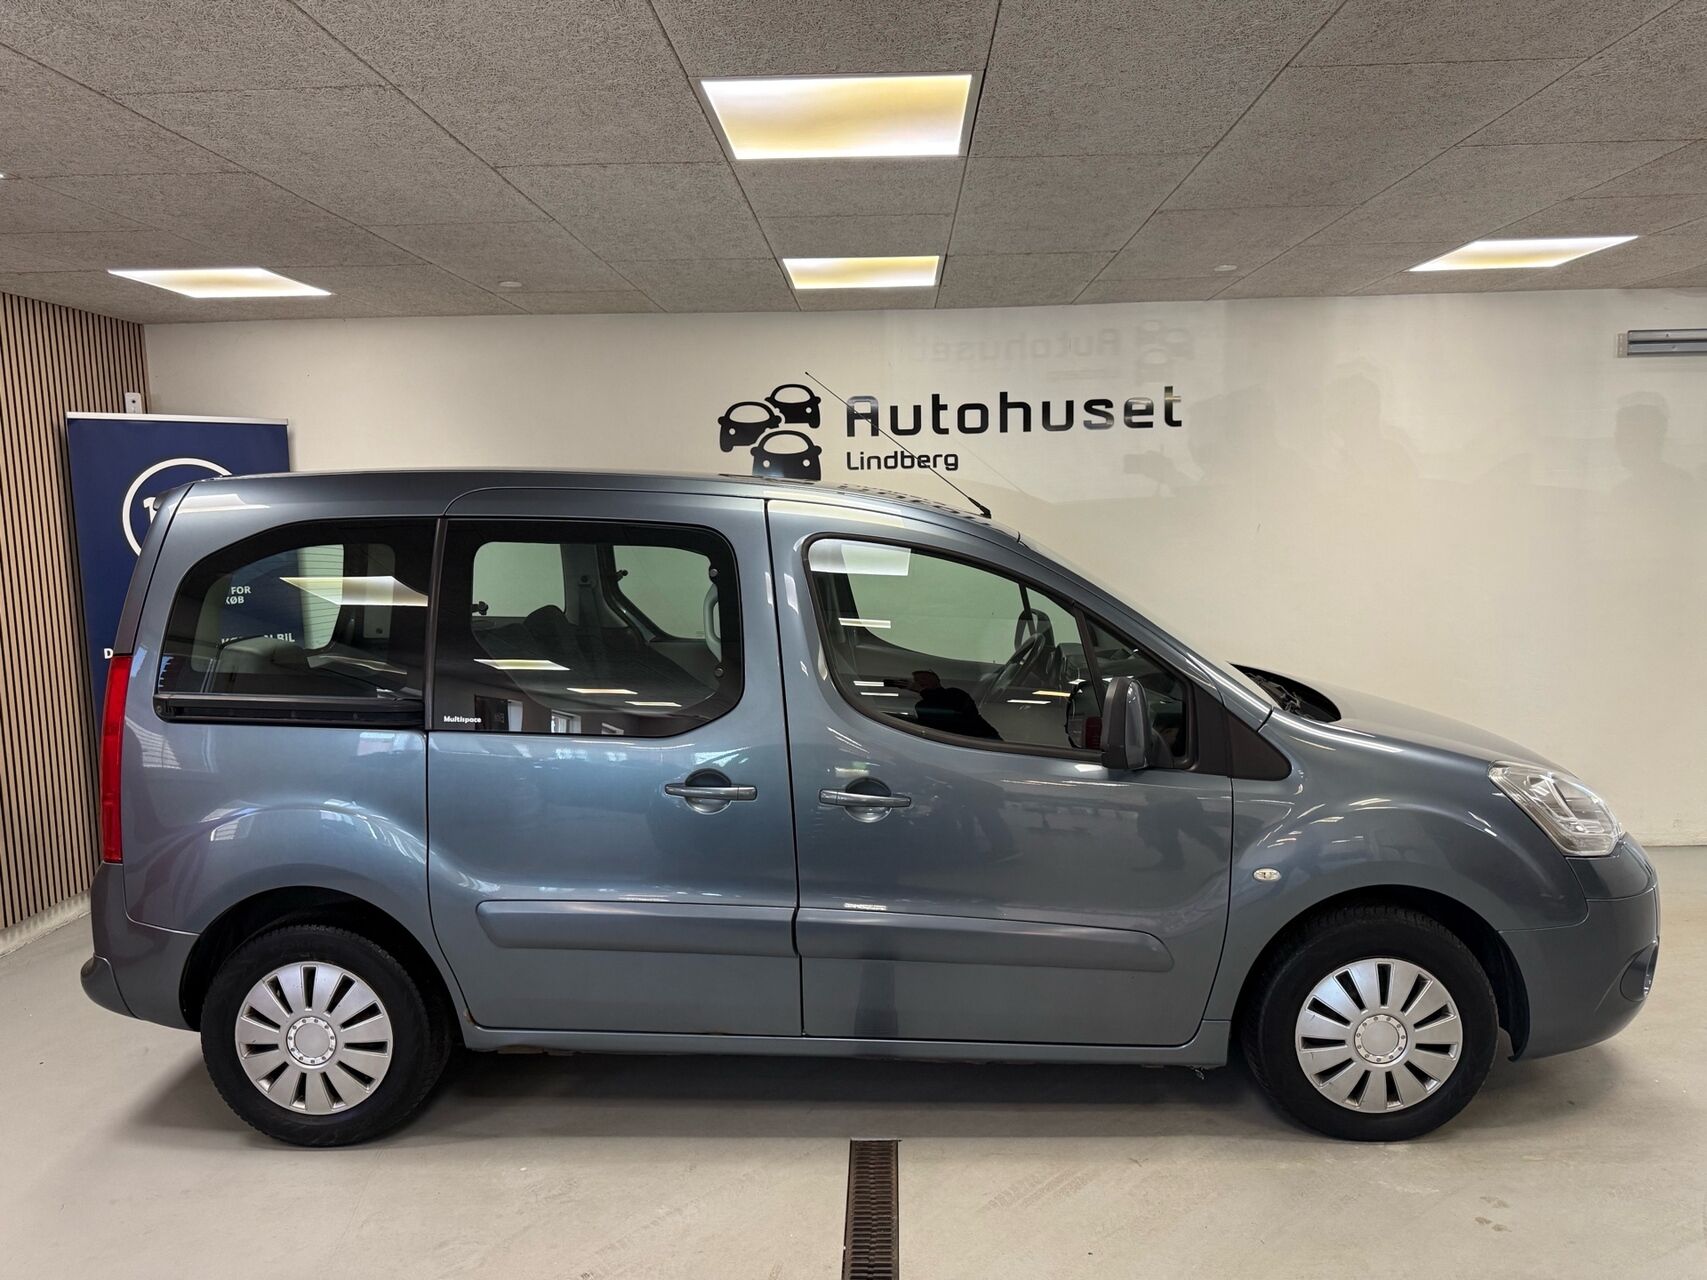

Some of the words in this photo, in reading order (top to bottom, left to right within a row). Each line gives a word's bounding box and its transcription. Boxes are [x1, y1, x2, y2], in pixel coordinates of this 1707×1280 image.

[847, 386, 1182, 436] Autohuset
[846, 451, 959, 471] Lindberg
[230, 585, 252, 595] FOR
[443, 715, 482, 724] Multispace
